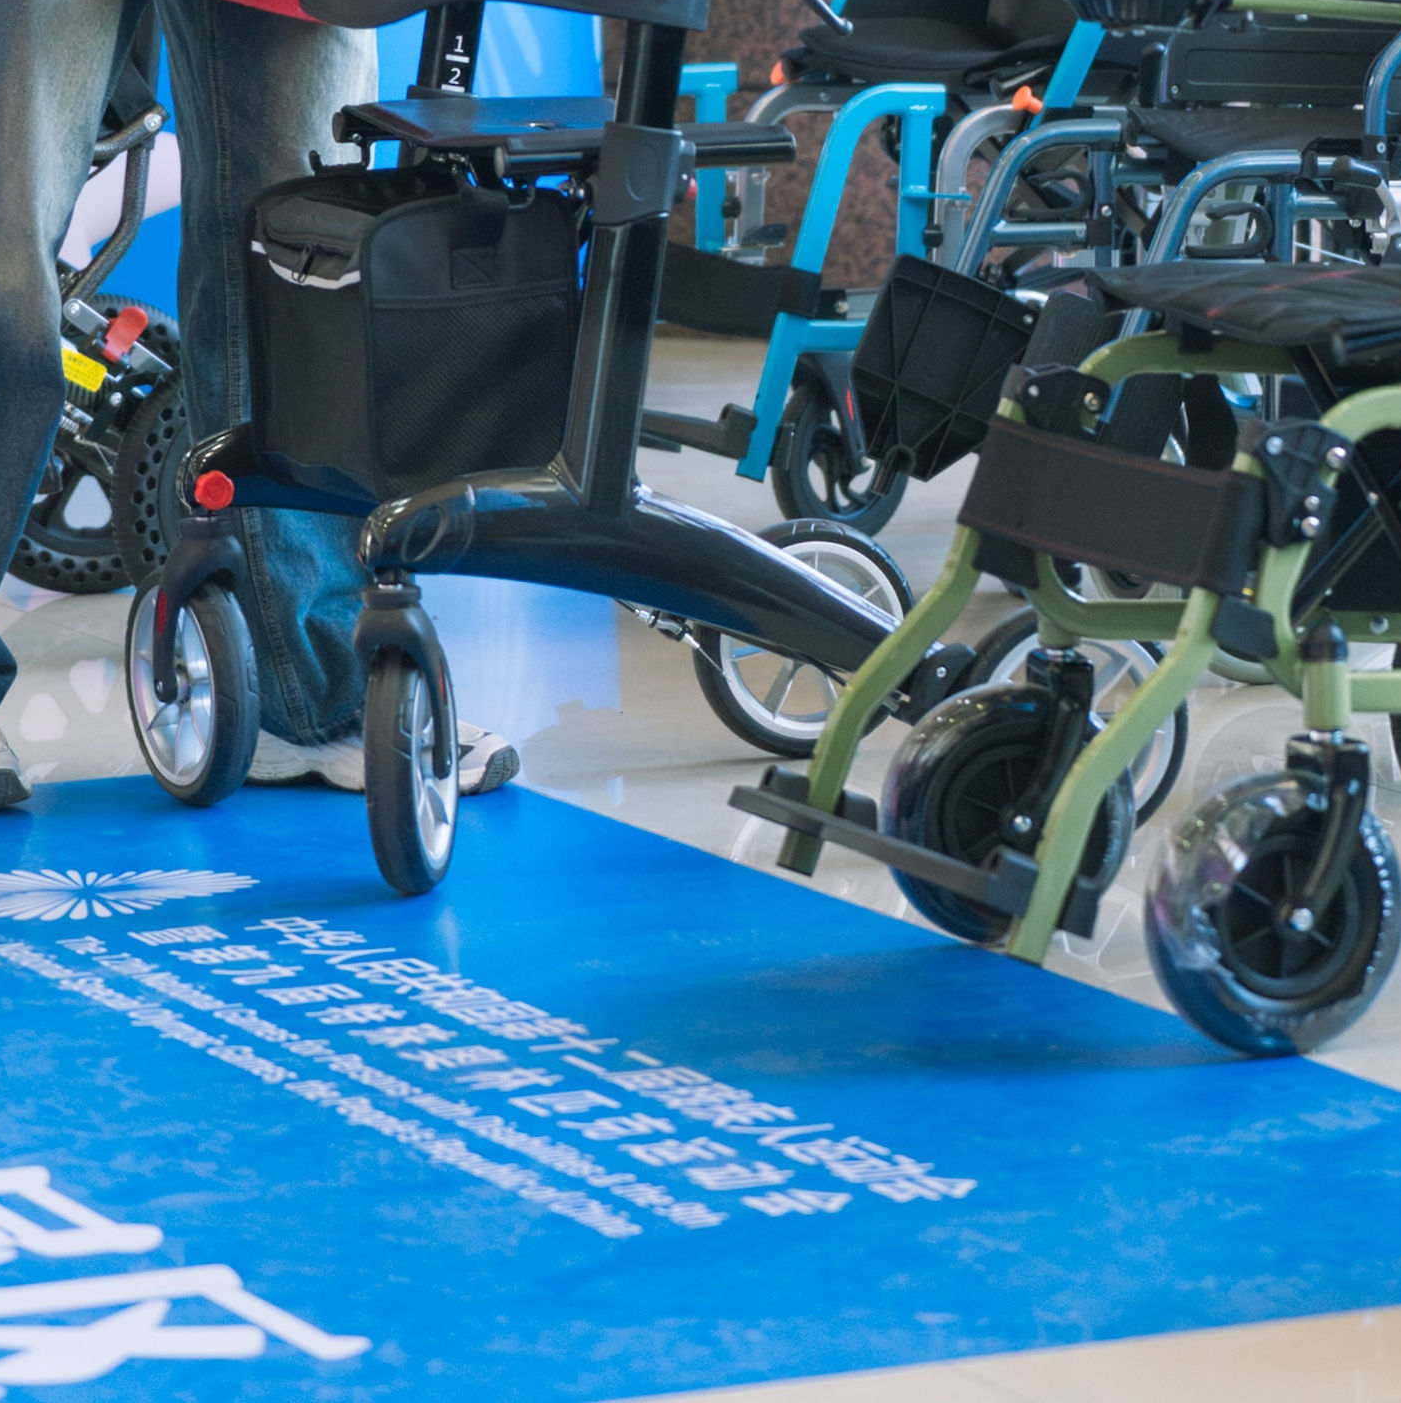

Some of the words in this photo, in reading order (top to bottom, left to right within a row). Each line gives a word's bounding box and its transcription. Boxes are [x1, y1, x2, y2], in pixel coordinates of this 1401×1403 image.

[448, 67, 462, 85] 2
[454, 35, 464, 53] 1
[127, 924, 853, 1216] 暨第九届特殊奥林匹克运动会
[244, 916, 978, 1203] 中华人民共和国第十二届残疾人运动会
